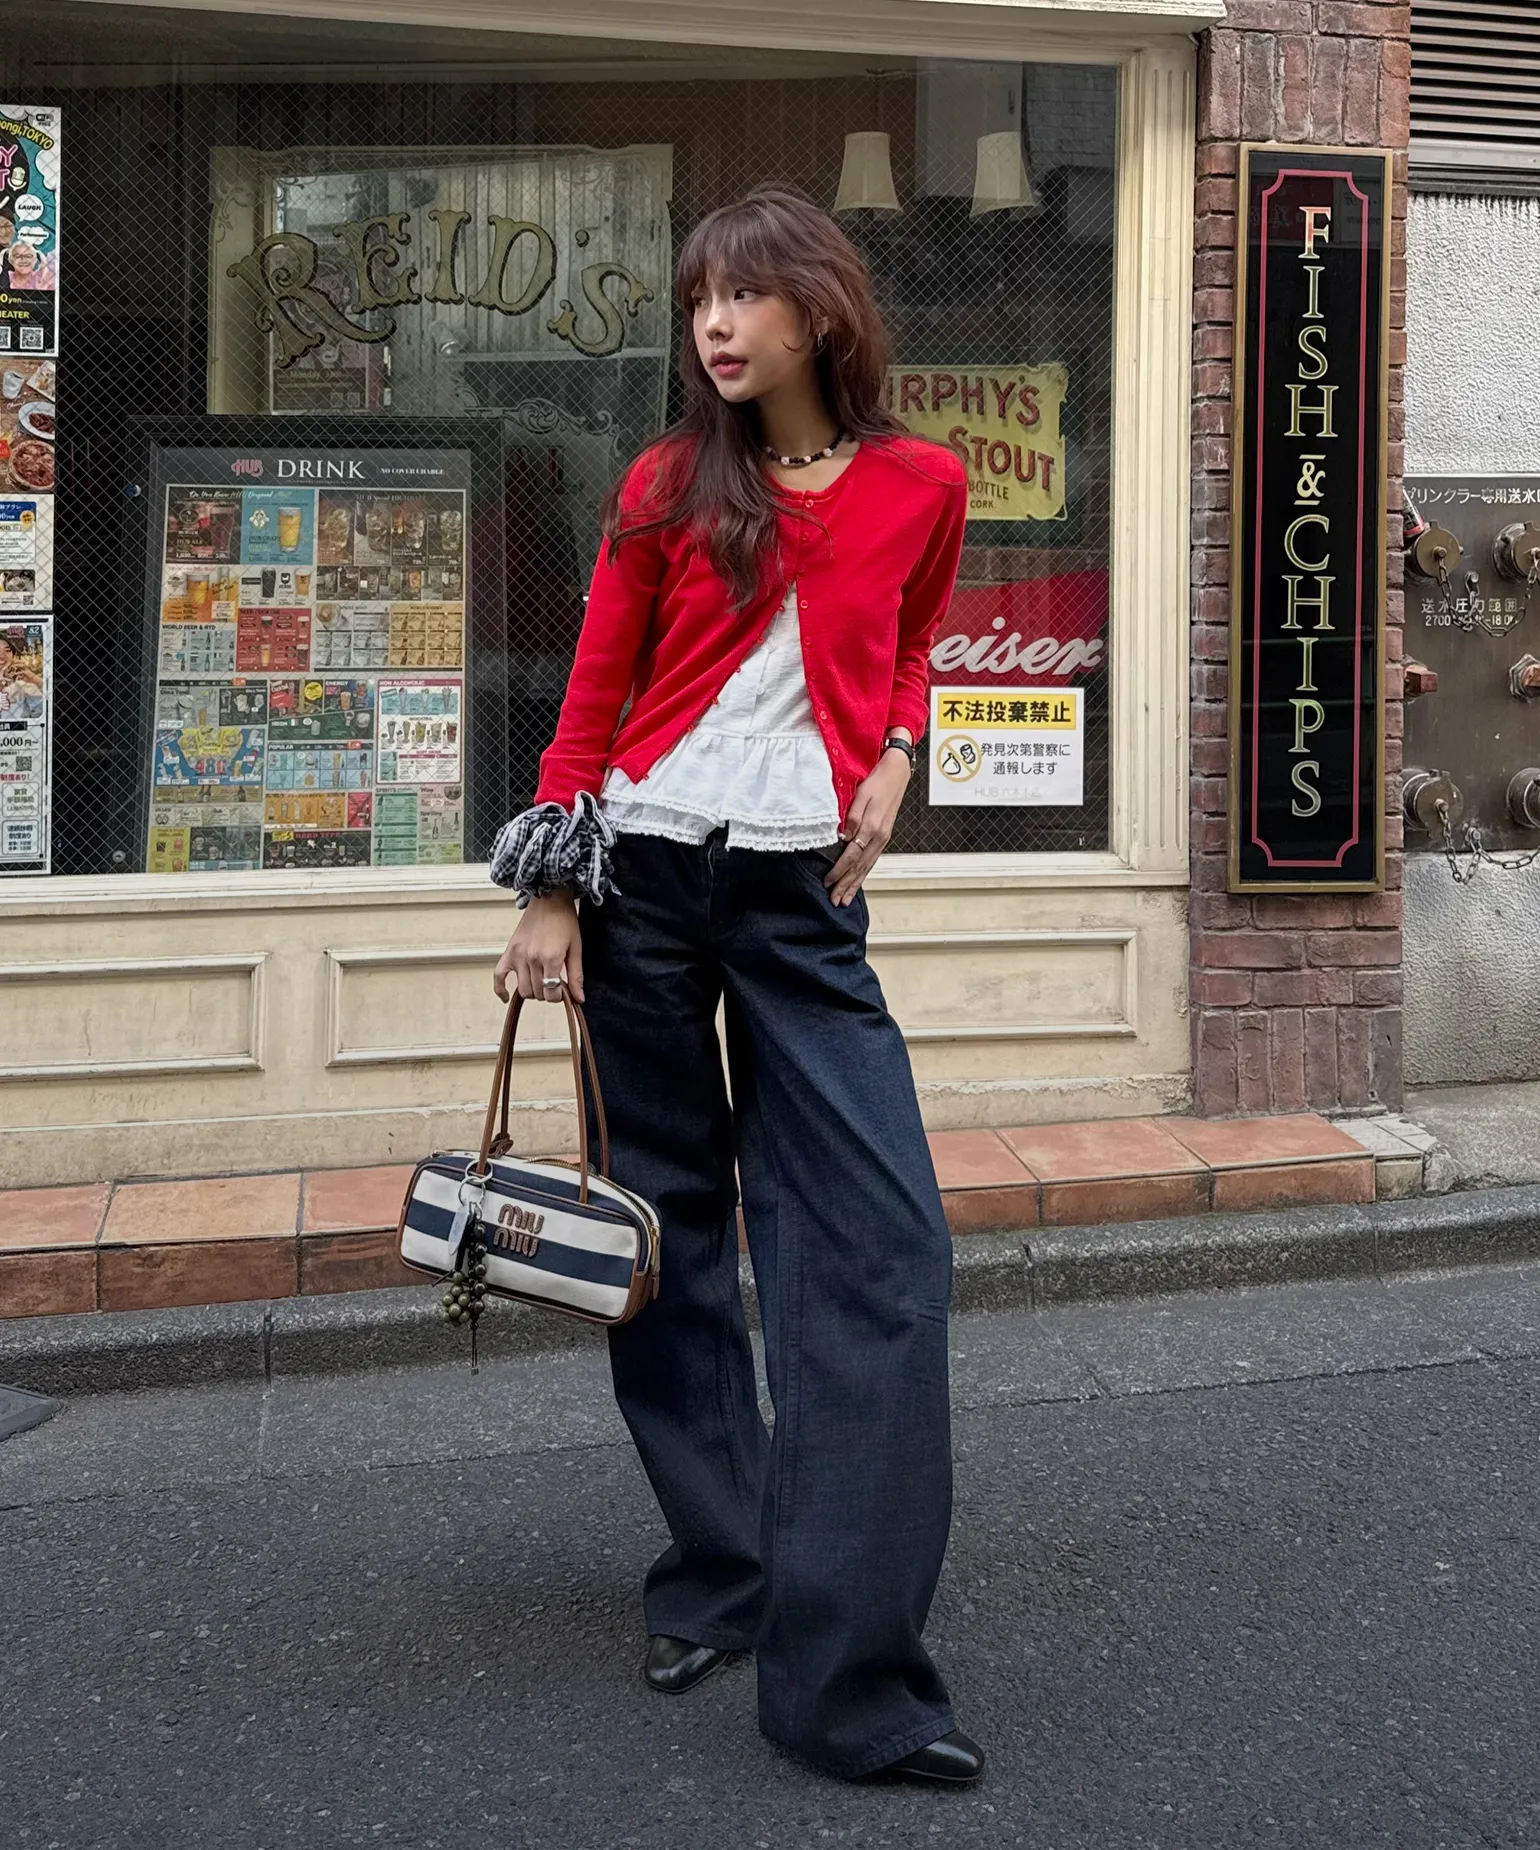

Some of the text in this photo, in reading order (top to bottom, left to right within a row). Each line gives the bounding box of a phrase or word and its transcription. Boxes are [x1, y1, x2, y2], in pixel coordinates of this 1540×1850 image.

[0, 120, 53, 150] ongi,TOKYO
[226, 210, 654, 368] REID'S
[1283, 206, 1339, 438] FISH
[277, 459, 366, 479] DRINK
[948, 425, 1055, 492] STOUT
[967, 480, 1009, 501] BOTTLE
[1296, 461, 1326, 498] &
[1281, 514, 1334, 818] CHIPS
[943, 700, 1071, 723] 不法投棄禁止
[981, 743, 1071, 757] 発見次第警察に
[993, 761, 1058, 776] 通報します
[974, 787, 999, 798] HUB
[498, 1203, 545, 1235] MIU
[493, 1227, 540, 1258] MIU
